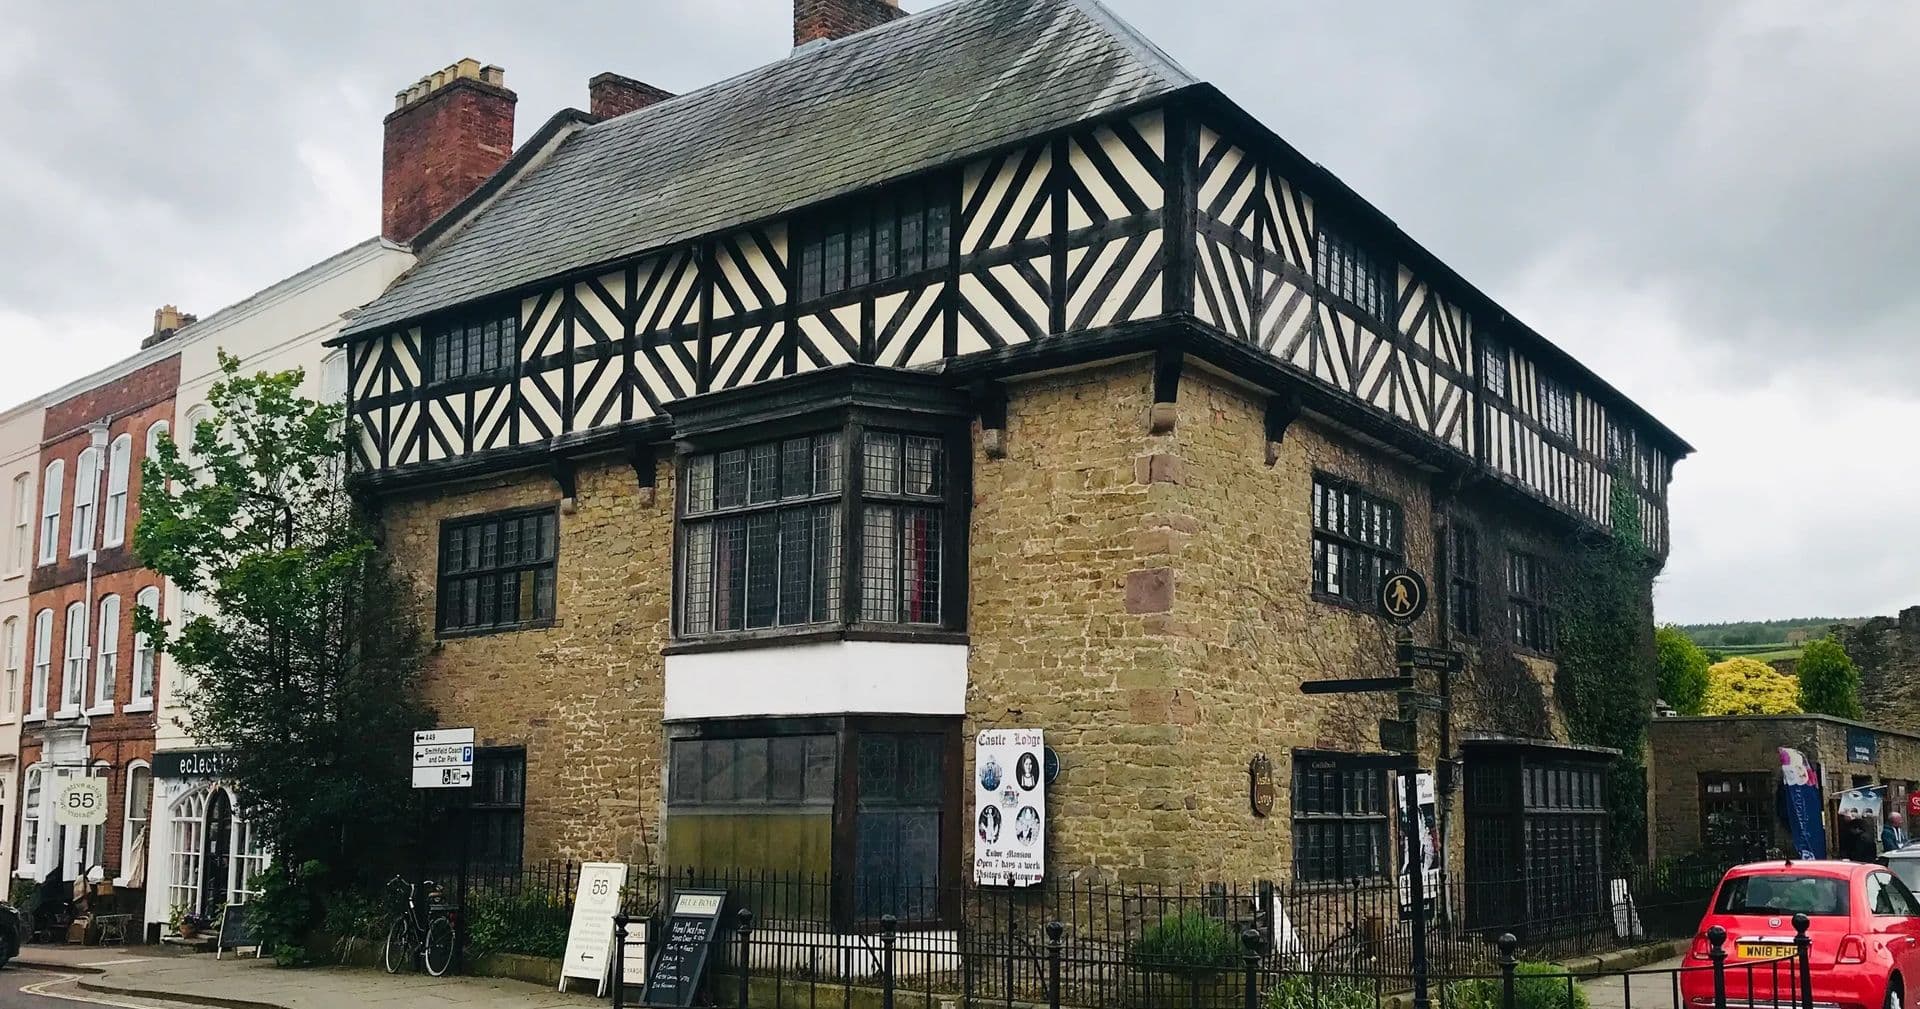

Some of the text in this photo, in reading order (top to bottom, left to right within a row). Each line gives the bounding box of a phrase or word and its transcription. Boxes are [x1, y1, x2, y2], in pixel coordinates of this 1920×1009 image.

[978, 732, 1041, 747] Castle Lodge
[425, 747, 447, 755] Smithfield
[448, 746, 462, 754] Coach
[429, 754, 457, 763] and Car Park
[68, 792, 95, 808] 55
[985, 848, 1032, 859] Tudor Mansion
[976, 858, 993, 869] Open
[1001, 860, 1016, 869] days
[1024, 861, 1041, 870] week
[976, 869, 1001, 880] Visitors
[592, 879, 609, 895] 55
[1746, 946, 1773, 957] WN18
